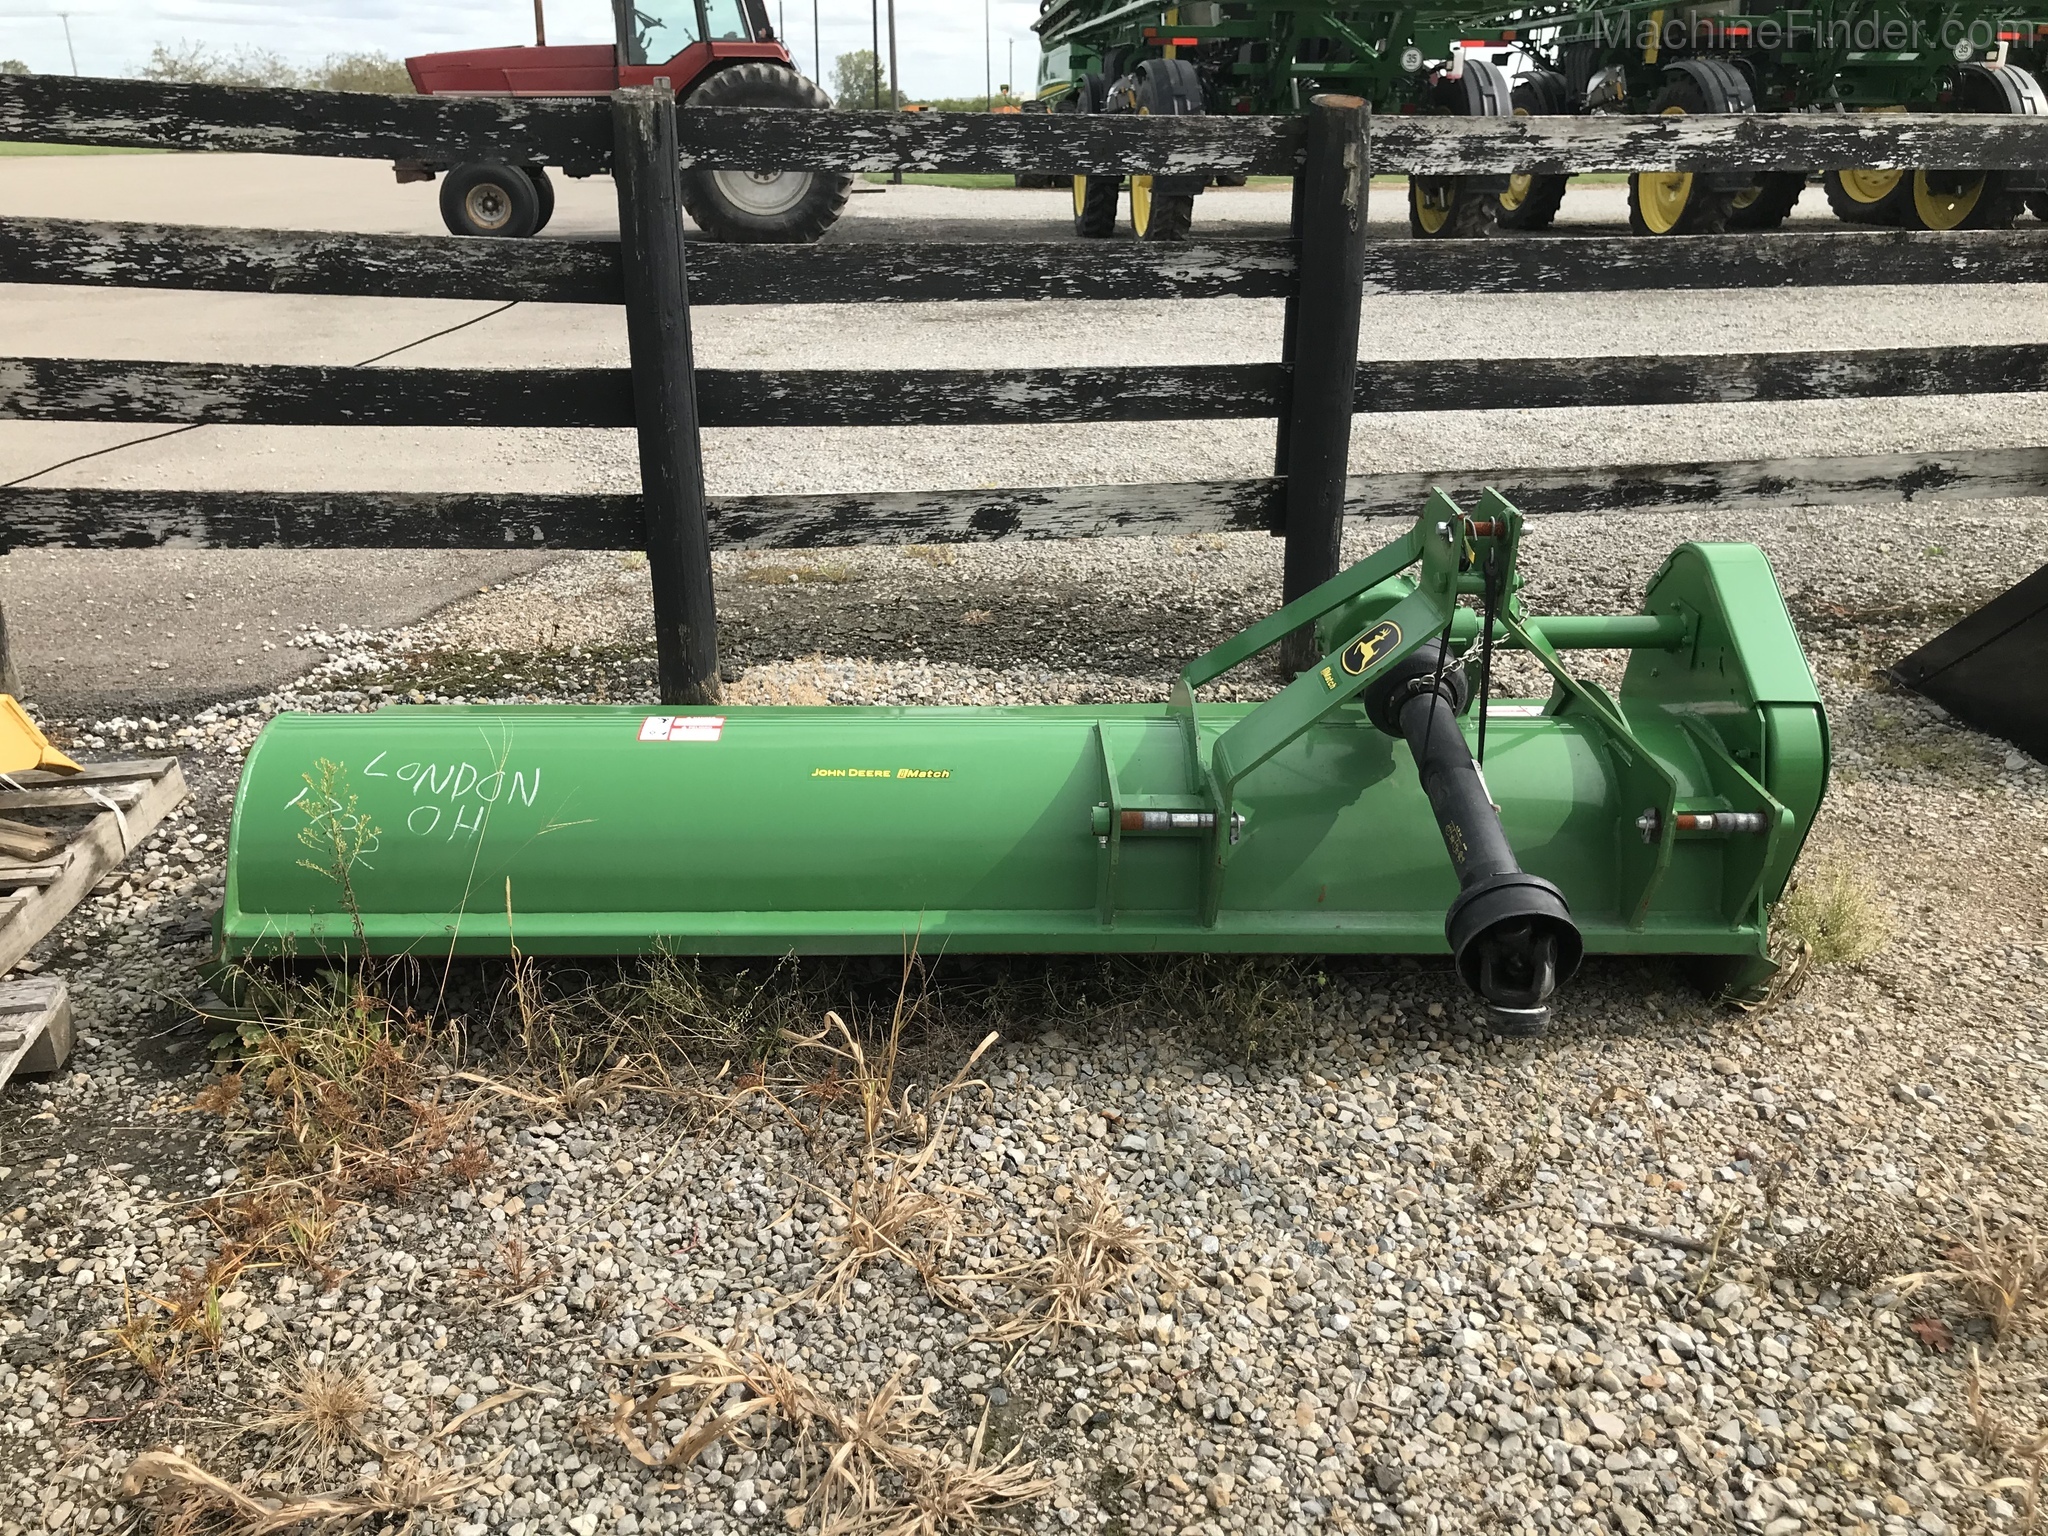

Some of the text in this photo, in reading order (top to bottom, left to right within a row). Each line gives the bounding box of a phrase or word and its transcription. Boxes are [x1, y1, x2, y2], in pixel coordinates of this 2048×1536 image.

[363, 750, 541, 808] LONDON
[811, 768, 846, 777] JOHN
[848, 768, 891, 777] DEERE
[407, 804, 485, 849] OH
